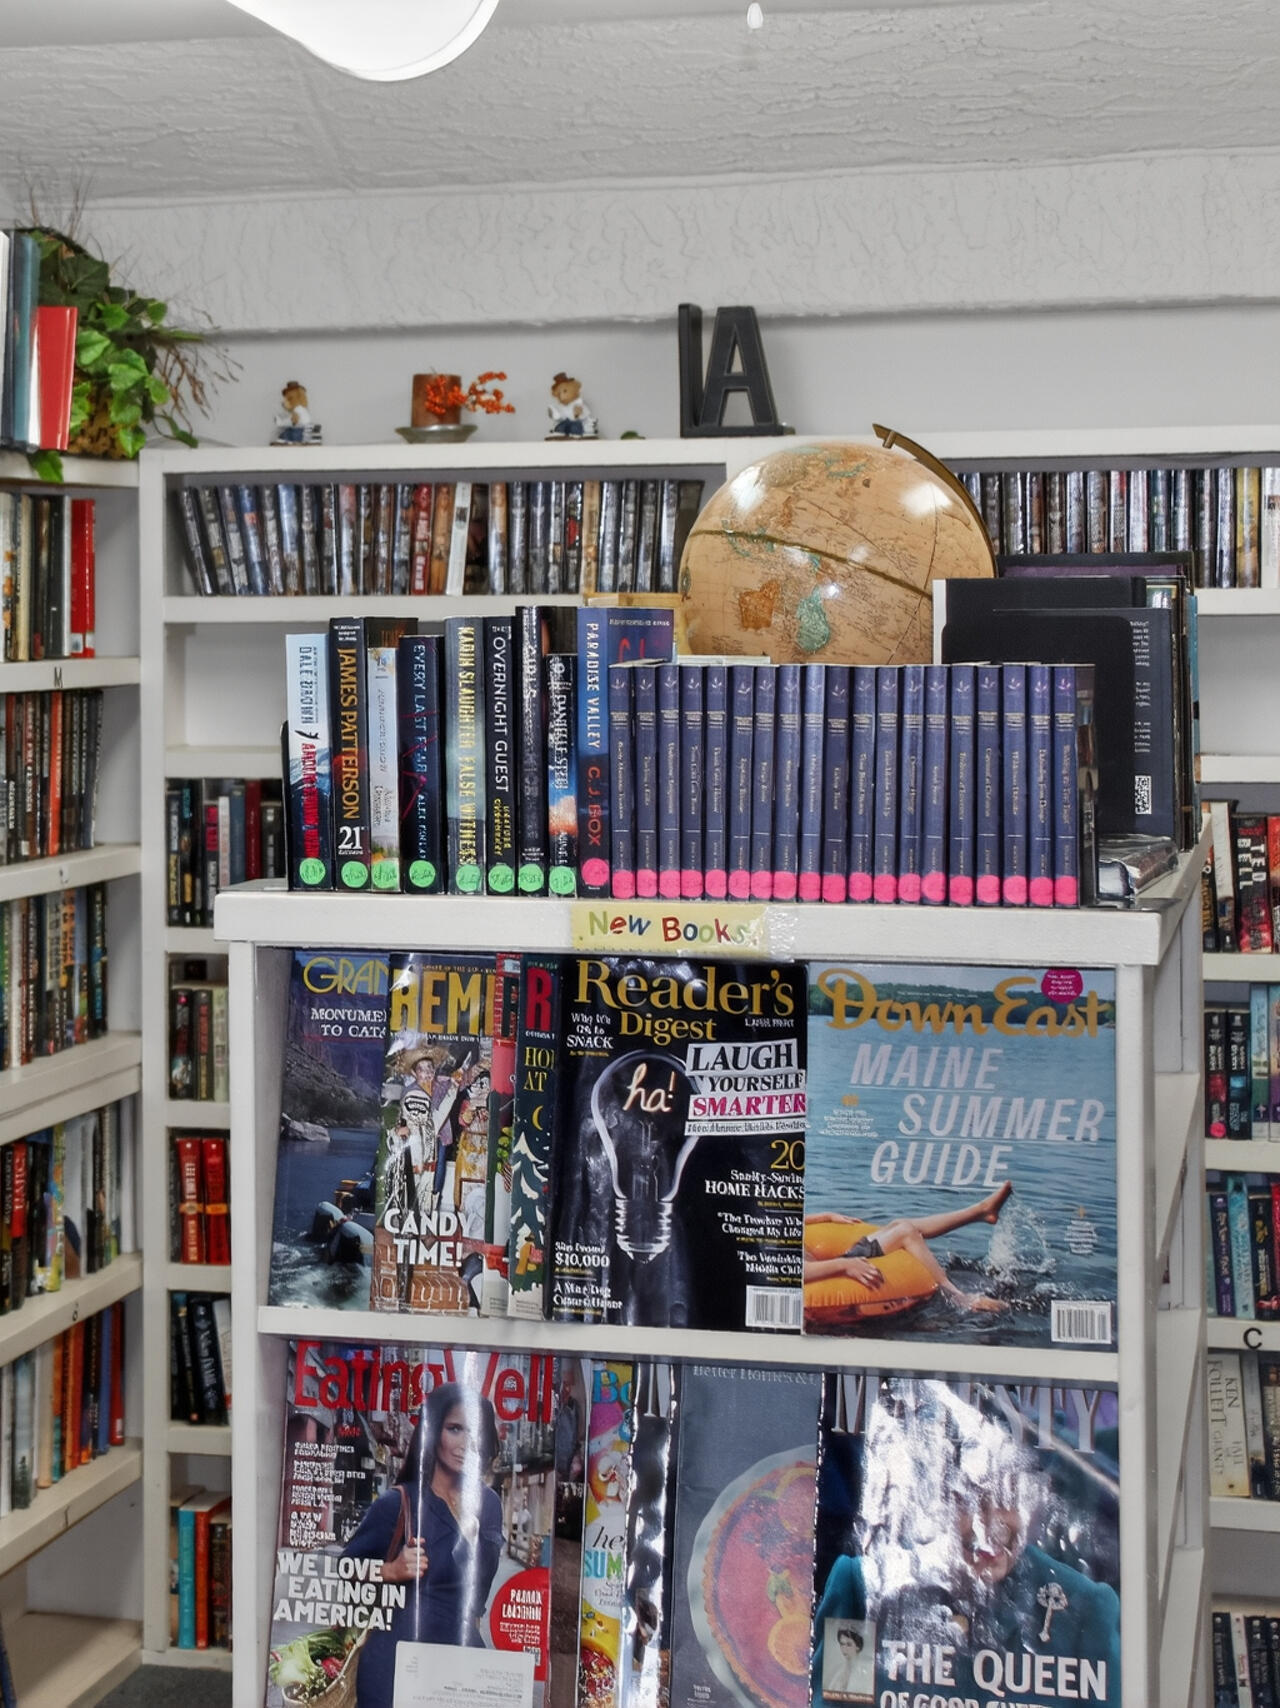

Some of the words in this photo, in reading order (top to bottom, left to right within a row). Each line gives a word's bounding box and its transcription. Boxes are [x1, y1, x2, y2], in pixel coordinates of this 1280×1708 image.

[587, 623, 599, 691] PARADISE
[337, 648, 359, 706] JAMES
[493, 637, 507, 735] OVERNIGHT
[587, 697, 600, 749] VALLEY
[340, 711, 360, 819] PATTERSON
[495, 740, 508, 793] GUEST
[1237, 838, 1251, 890] BELL
[1251, 844, 1266, 882] TED
[589, 911, 651, 937] New
[574, 960, 794, 1016] Reader's
[817, 968, 988, 1035] Down
[992, 976, 1111, 1038] East
[320, 1023, 343, 1037] TO
[566, 1035, 614, 1049] SNACK
[619, 1011, 717, 1046] Digest
[691, 1044, 793, 1071] LAUGH
[850, 1044, 1004, 1090] MAINE
[709, 1073, 803, 1092] YOURSELF
[693, 1094, 806, 1116] SMARTER
[898, 1093, 1105, 1142] SUMMER
[870, 1141, 1013, 1187] GUIDE
[705, 1181, 751, 1196] HOME
[754, 1182, 805, 1199] HACKS
[384, 1209, 469, 1235] CANDY
[393, 1240, 463, 1268] TIME!
[1243, 1326, 1263, 1350] C
[1207, 1360, 1227, 1428] FOLLETT
[1224, 1377, 1239, 1409] KEN
[278, 1552, 320, 1577] WE
[325, 1554, 384, 1581] LOVE
[288, 1576, 378, 1605] EATING
[382, 1583, 405, 1608] IN
[274, 1600, 393, 1631] AMERICA!
[882, 1640, 956, 1686] THE
[973, 1649, 1107, 1701] QUEEN
